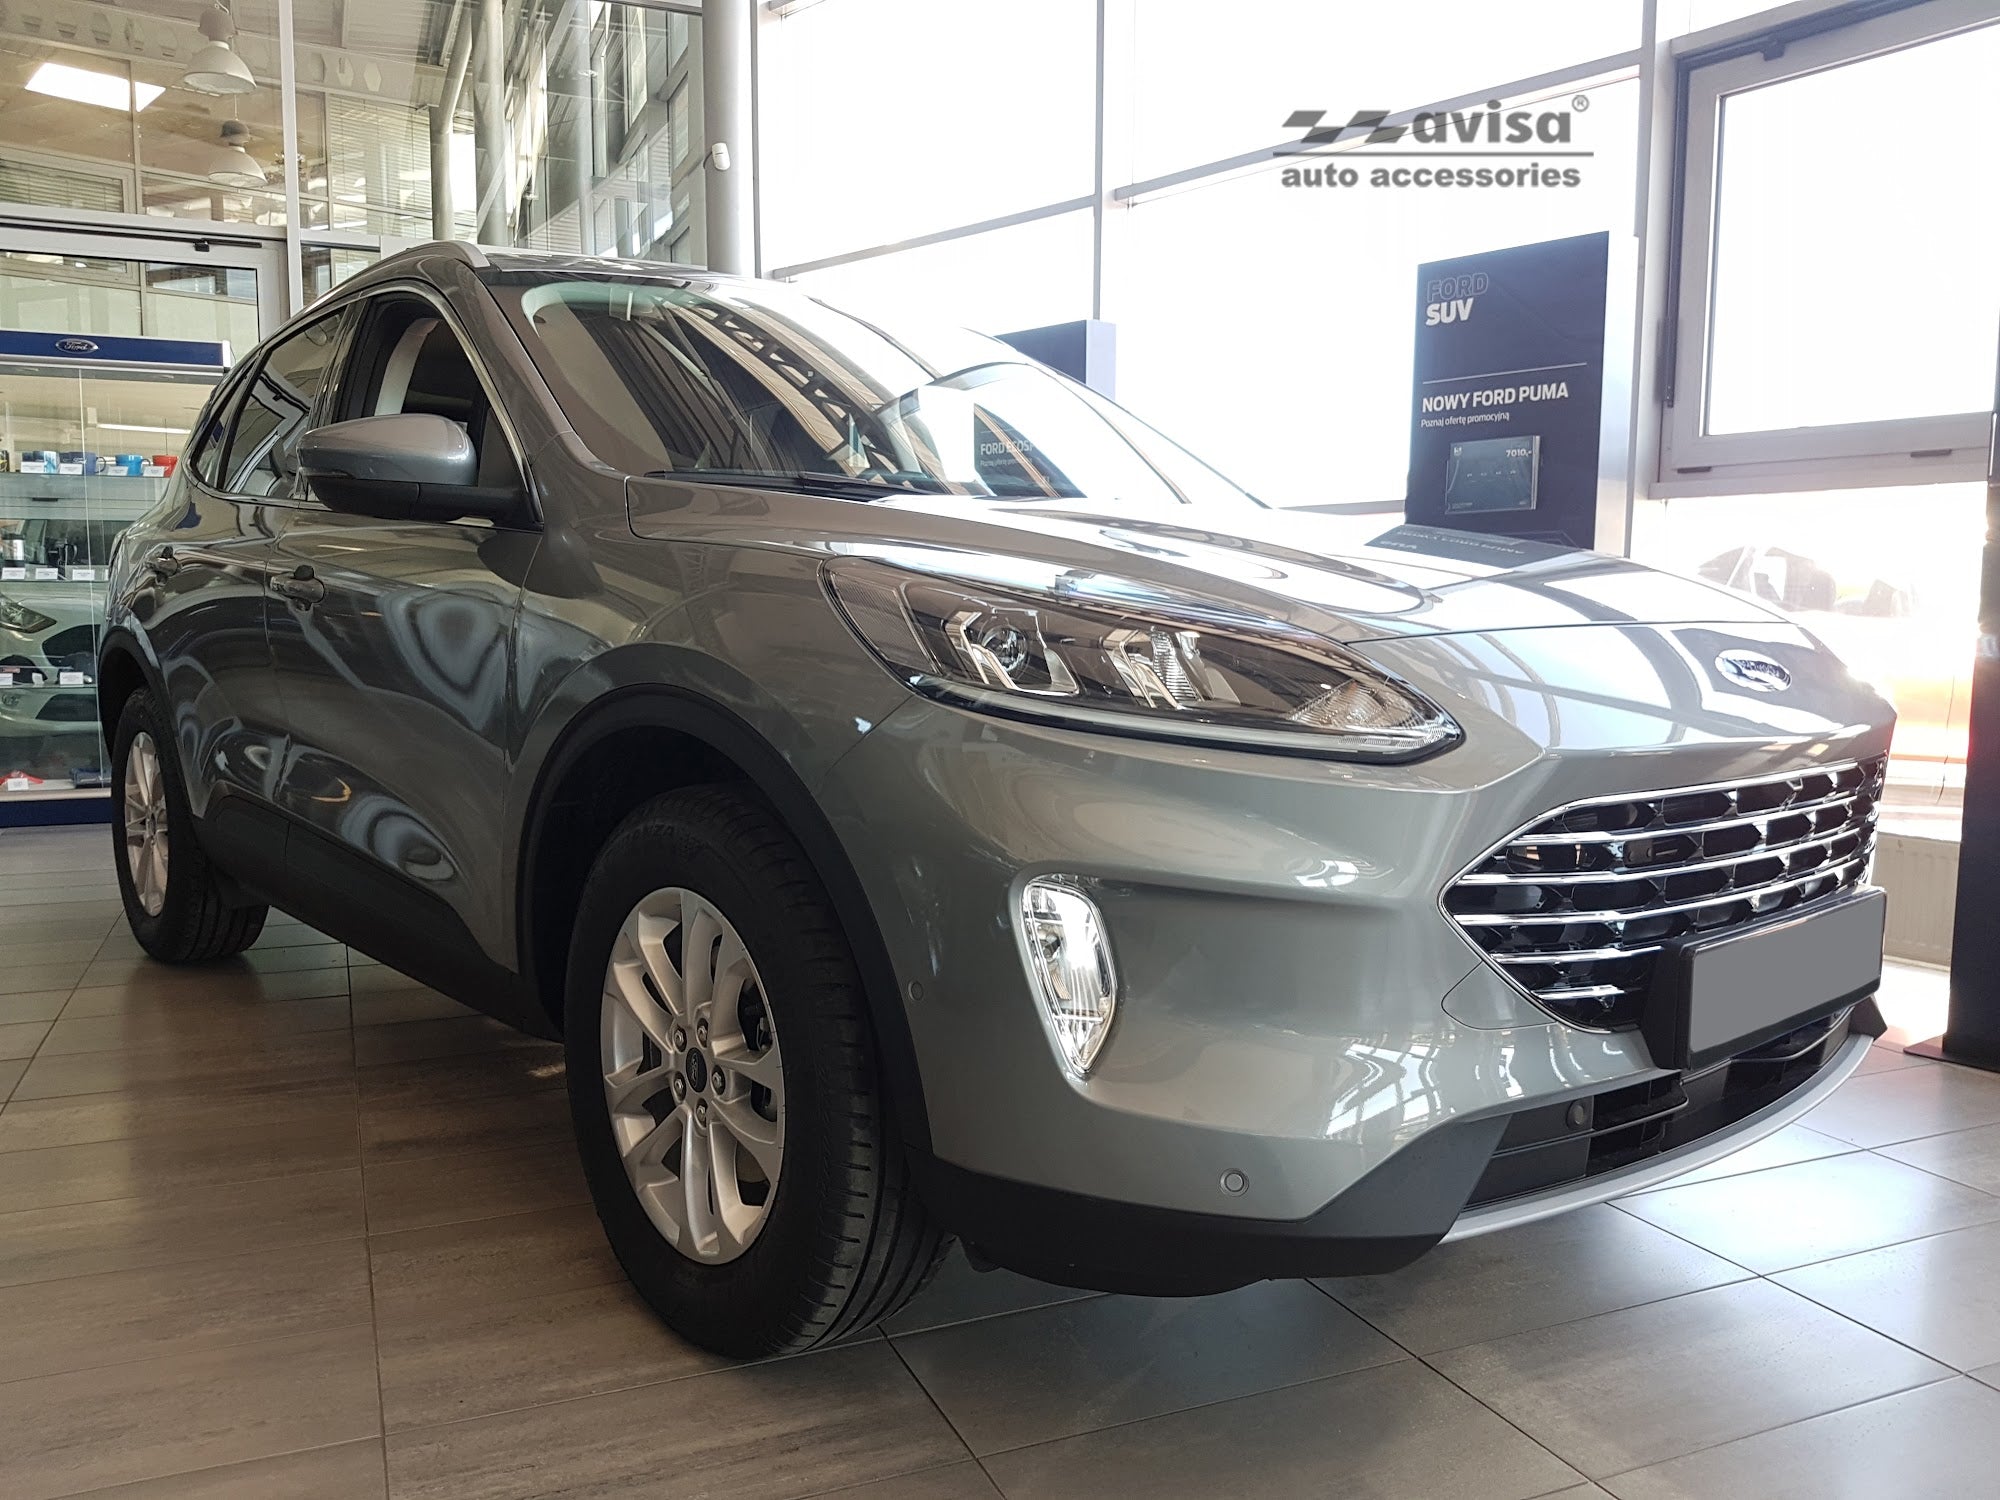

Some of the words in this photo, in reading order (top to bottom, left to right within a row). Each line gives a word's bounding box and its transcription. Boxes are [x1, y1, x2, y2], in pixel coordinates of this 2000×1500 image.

[1427, 272, 1489, 303] FORD
[1425, 297, 1474, 326] SUV
[1422, 393, 1470, 413] NOWY
[1472, 388, 1516, 407] FORD
[1519, 382, 1569, 402] PUMA
[1421, 417, 1444, 428] Poznaj
[1467, 411, 1510, 424] promocyjną
[980, 442, 1005, 455] FORD
